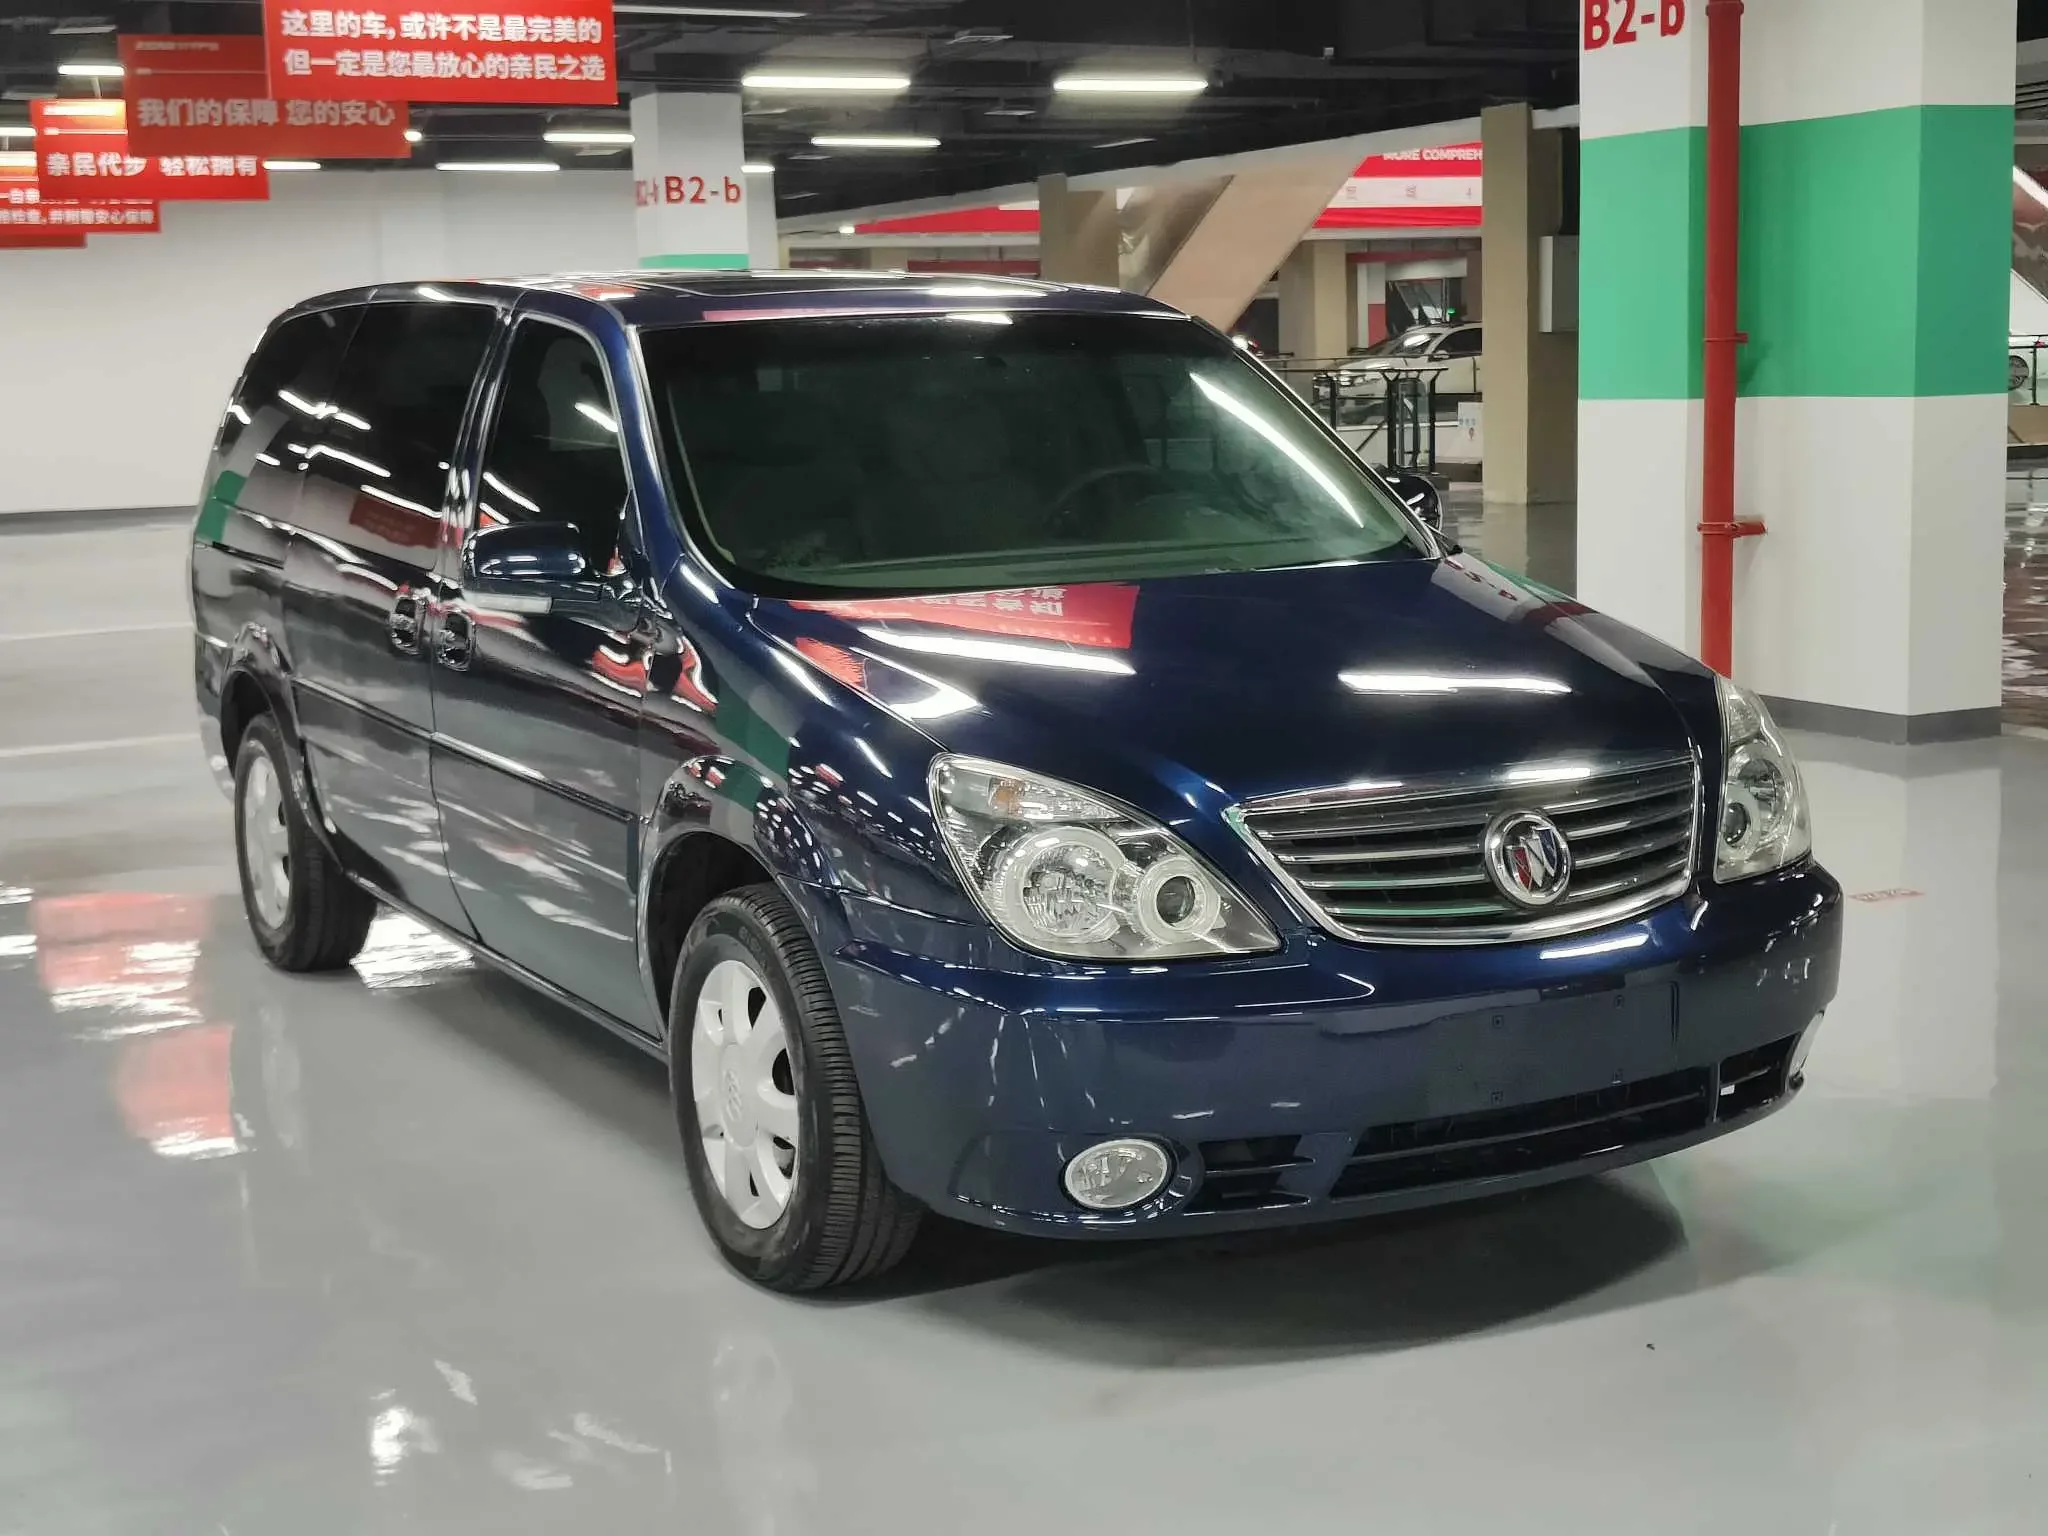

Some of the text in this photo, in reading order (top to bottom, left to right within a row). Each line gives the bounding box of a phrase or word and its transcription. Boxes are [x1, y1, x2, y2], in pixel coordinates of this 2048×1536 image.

[283, 49, 606, 81] 但一定是您最放心的亲民之选
[137, 97, 396, 127] 我们的保障 您的安心
[47, 151, 258, 177] 亲民代步 轻松拥有
[664, 175, 742, 204] B2-b
